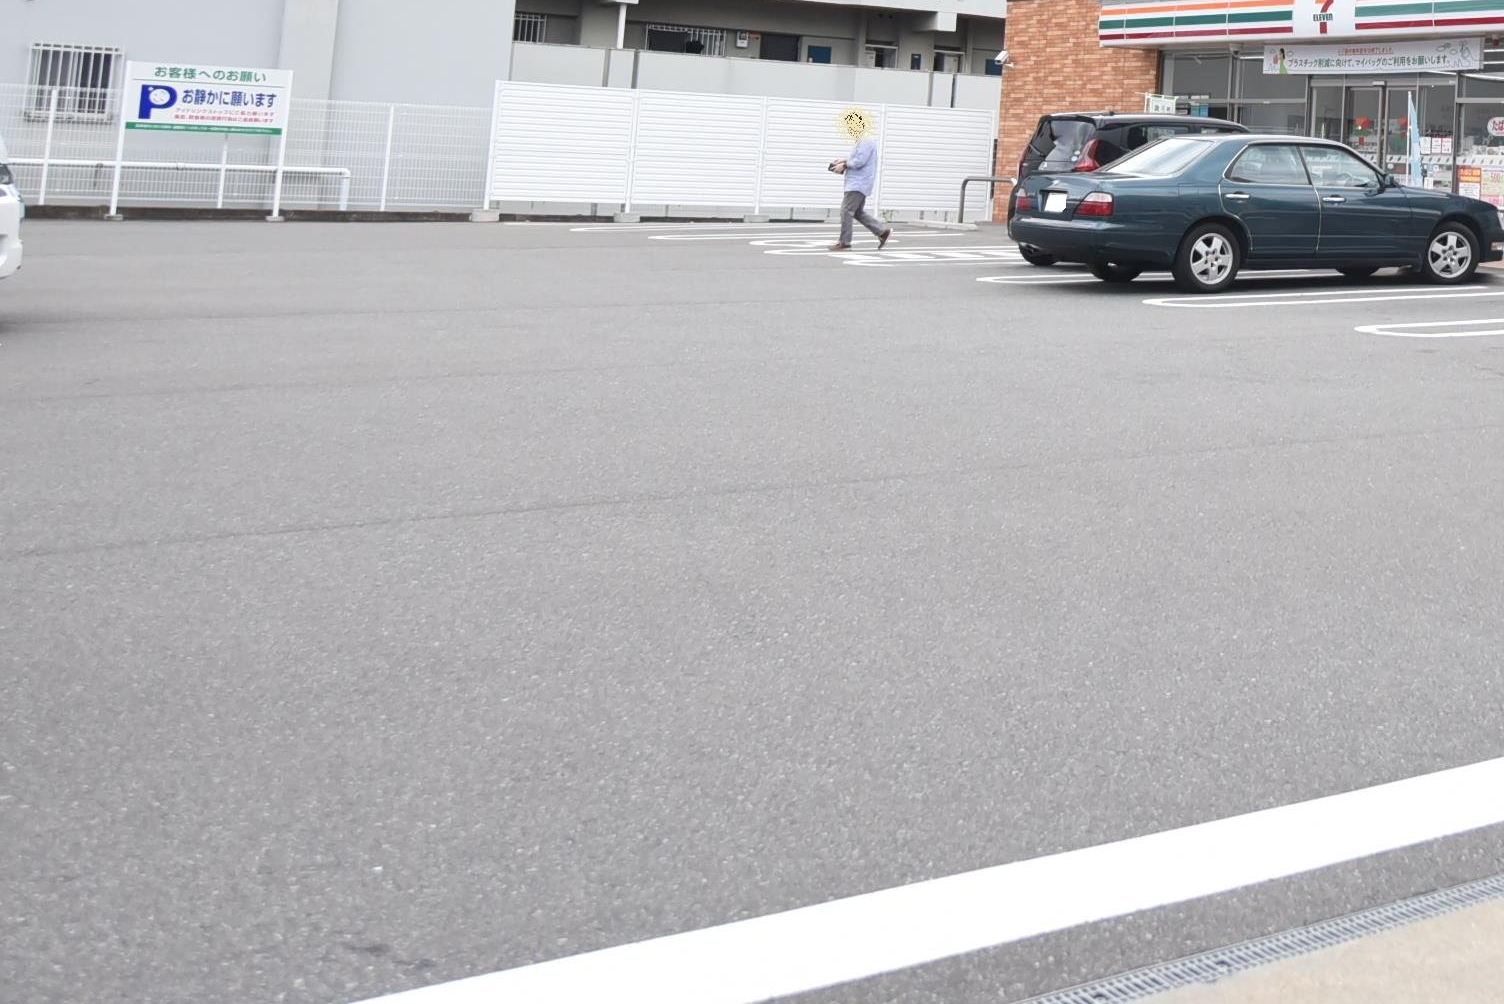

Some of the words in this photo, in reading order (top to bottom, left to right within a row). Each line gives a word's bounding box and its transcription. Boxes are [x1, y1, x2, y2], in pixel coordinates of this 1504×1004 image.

[154, 66, 267, 83] お客様へのお願い
[138, 84, 178, 120] P
[182, 89, 277, 108] お静かに願います
